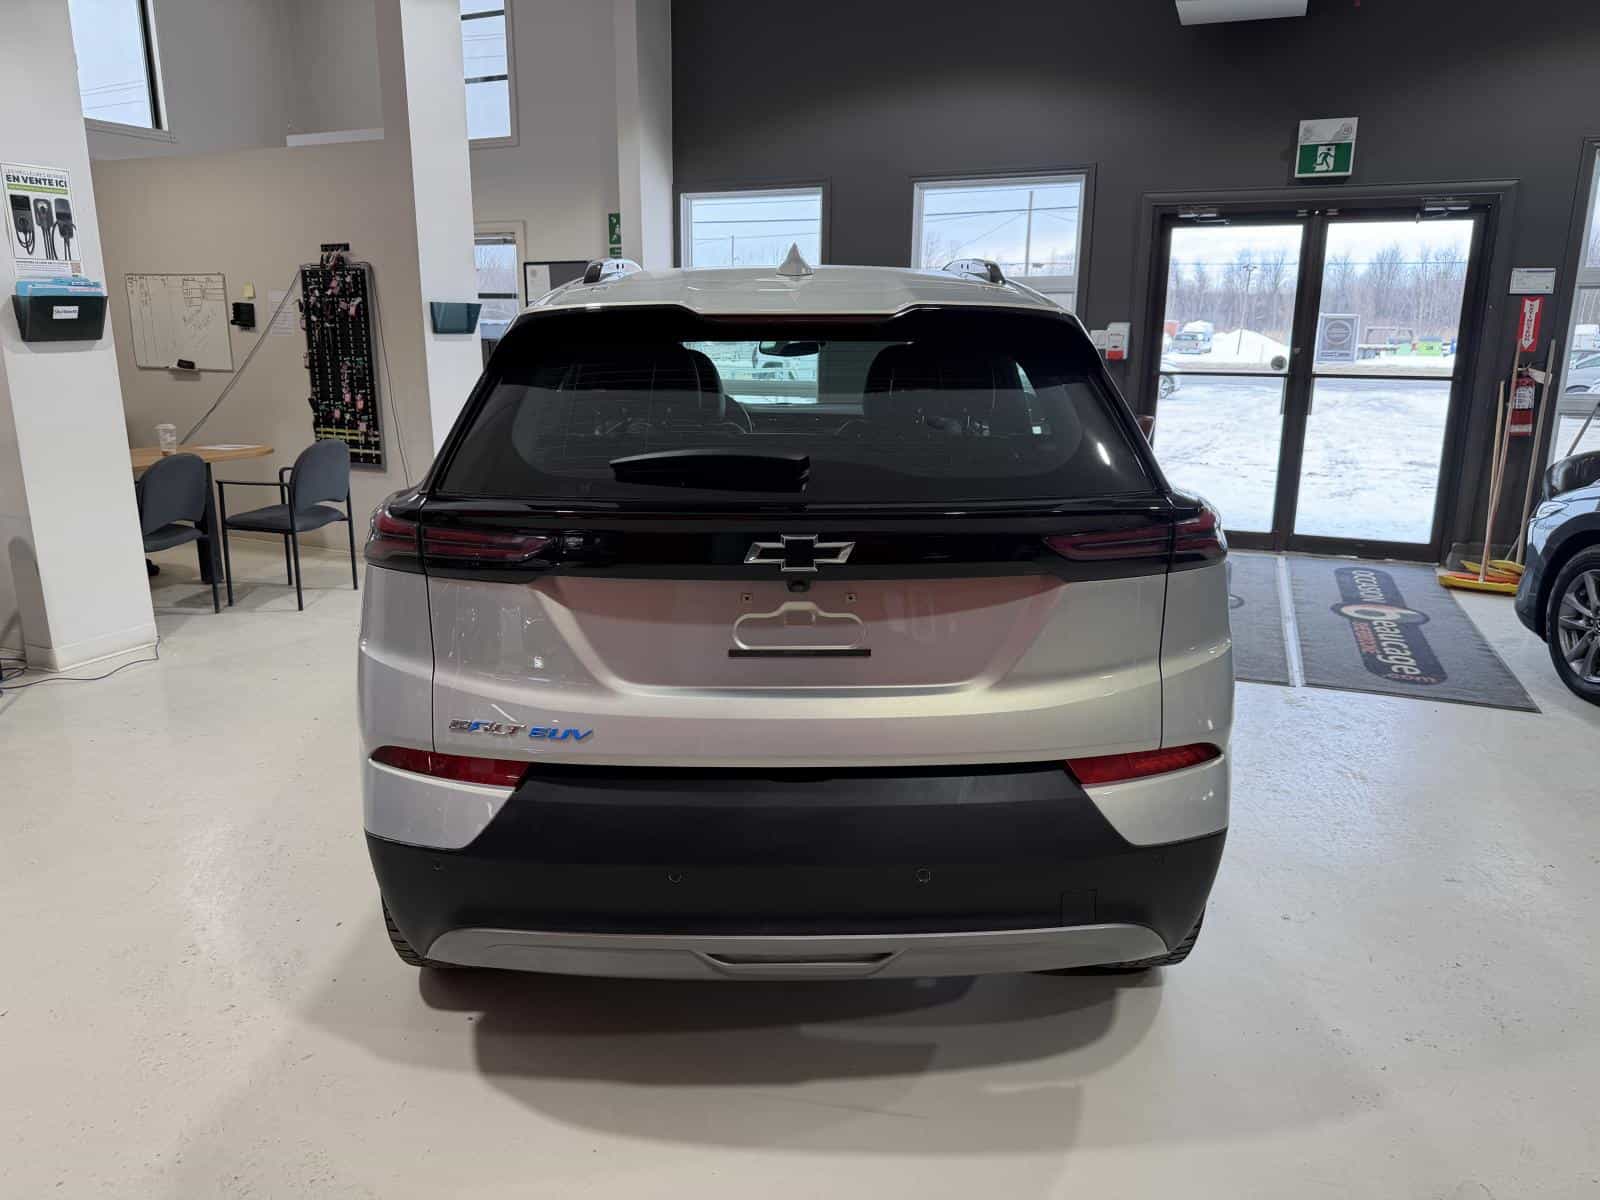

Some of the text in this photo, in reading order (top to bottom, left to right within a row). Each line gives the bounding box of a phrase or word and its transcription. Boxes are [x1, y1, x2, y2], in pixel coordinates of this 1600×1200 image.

[6, 174, 68, 188] EN VENTE ICI
[449, 718, 594, 741] BOLT EUV
